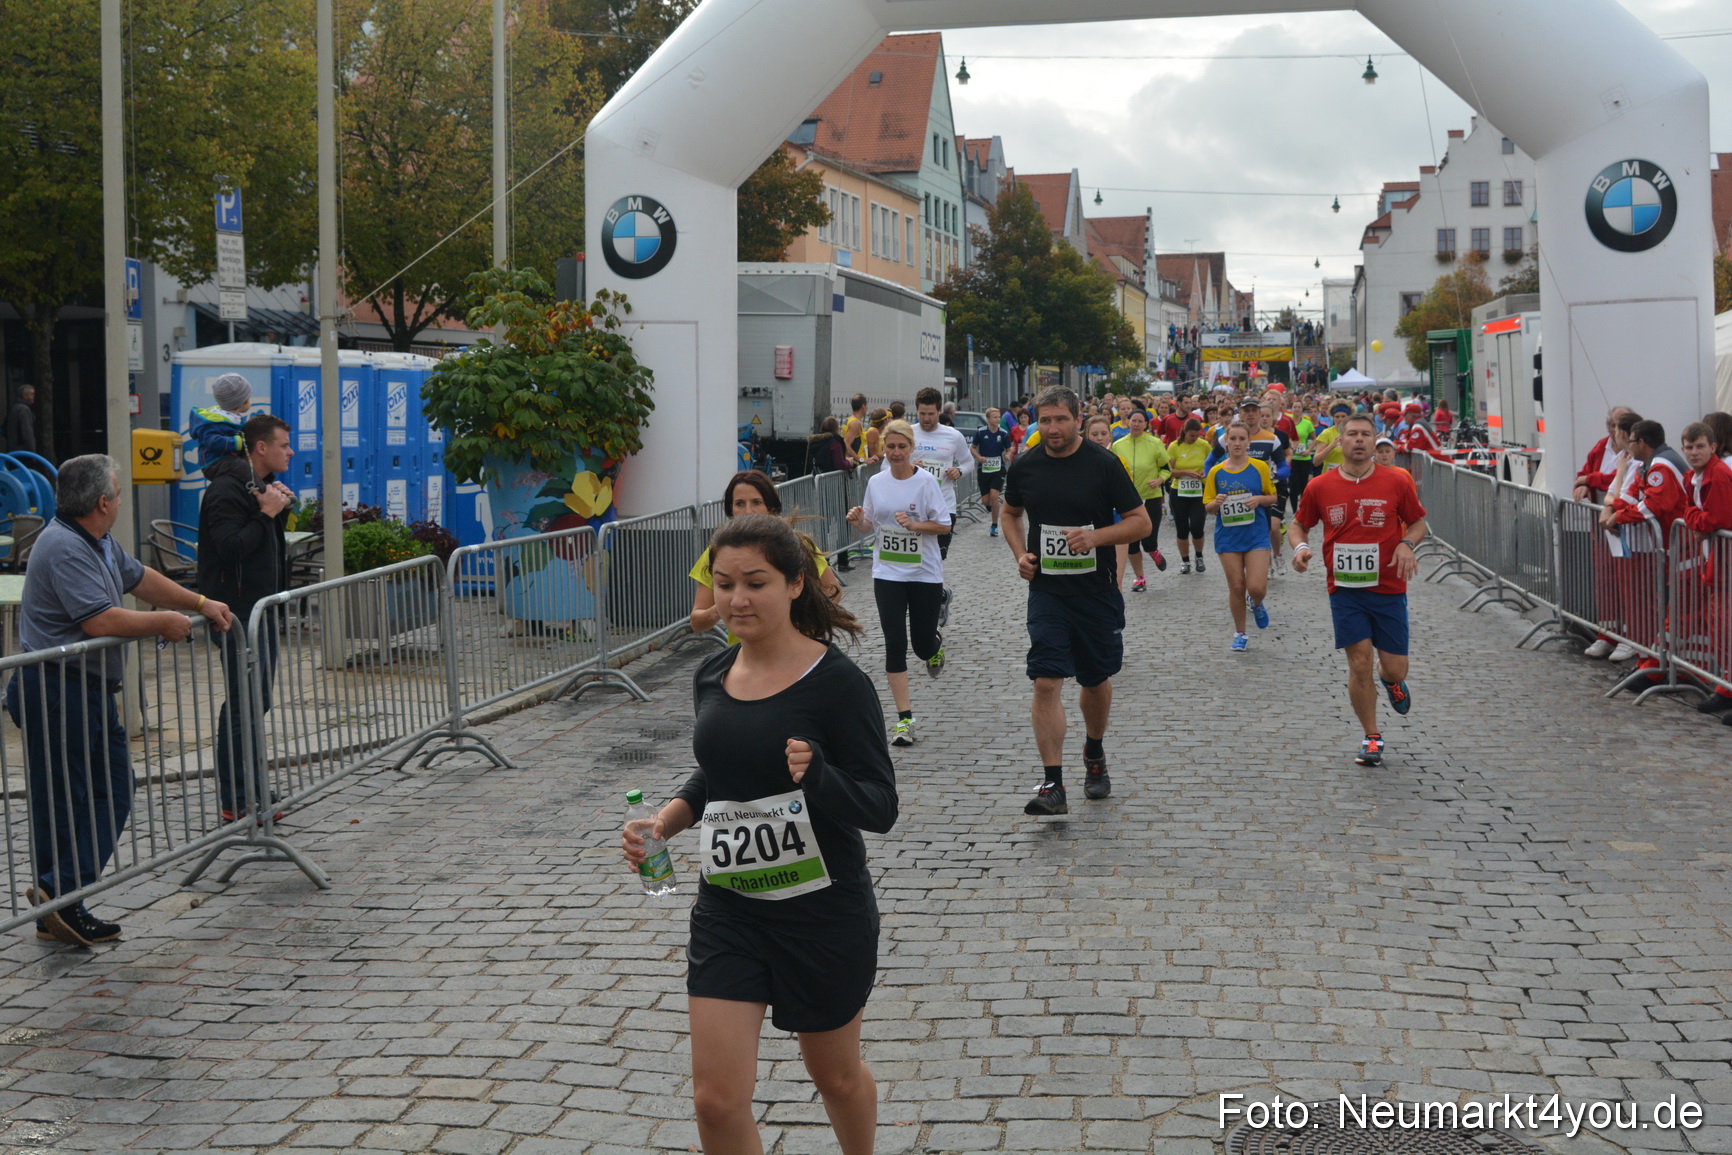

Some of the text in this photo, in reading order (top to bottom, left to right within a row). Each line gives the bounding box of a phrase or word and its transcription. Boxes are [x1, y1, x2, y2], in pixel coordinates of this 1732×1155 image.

[163, 344, 170, 362] 3
[388, 386, 407, 409] DIXI
[1180, 481, 1200, 489] 5165
[883, 535, 918, 552] 5515
[1337, 554, 1374, 570] 5116
[703, 807, 785, 823] PARTL Neumarkt
[711, 821, 806, 868] 5204
[730, 870, 799, 890] Charlotte
